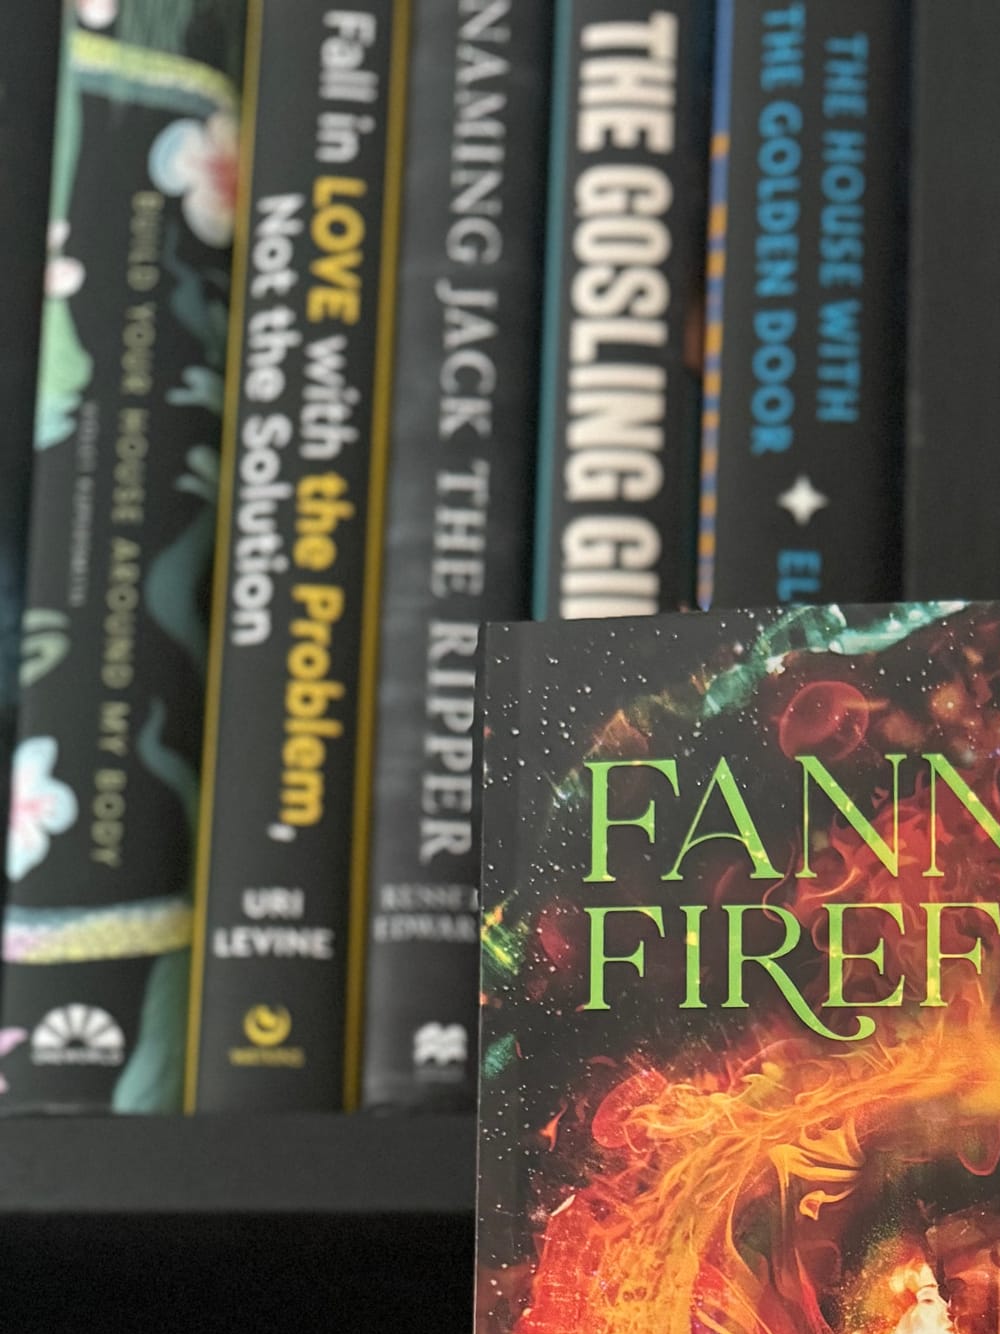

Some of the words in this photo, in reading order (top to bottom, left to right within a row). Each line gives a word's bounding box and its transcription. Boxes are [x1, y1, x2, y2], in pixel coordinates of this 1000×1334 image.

[317, 10, 377, 103] Fall
[577, 10, 679, 154] THE
[760, 3, 805, 91] THE
[823, 34, 868, 118] THE
[316, 112, 375, 163] in
[444, 0, 510, 265] NAMING
[127, 191, 164, 291] BUILD
[253, 194, 303, 298] Not
[306, 176, 365, 324] LOVE
[755, 100, 803, 297] GOLDEN
[819, 129, 865, 286] HOUSE
[121, 301, 157, 395] YOUR
[245, 306, 300, 402] the
[435, 279, 499, 440] JACK
[563, 163, 673, 503] GOSLING
[750, 308, 796, 454] DOOR
[816, 298, 861, 423] WITH
[300, 335, 358, 458] with
[112, 410, 149, 524] HOUSE
[292, 471, 353, 570] the
[231, 413, 292, 646] Solution
[431, 462, 490, 598] THE
[102, 539, 140, 689] AROUND
[98, 701, 130, 756] MY
[420, 619, 480, 865] RIPPER
[89, 768, 126, 867] BODY
[214, 927, 334, 960] LEVINE
[242, 888, 305, 920] URI
